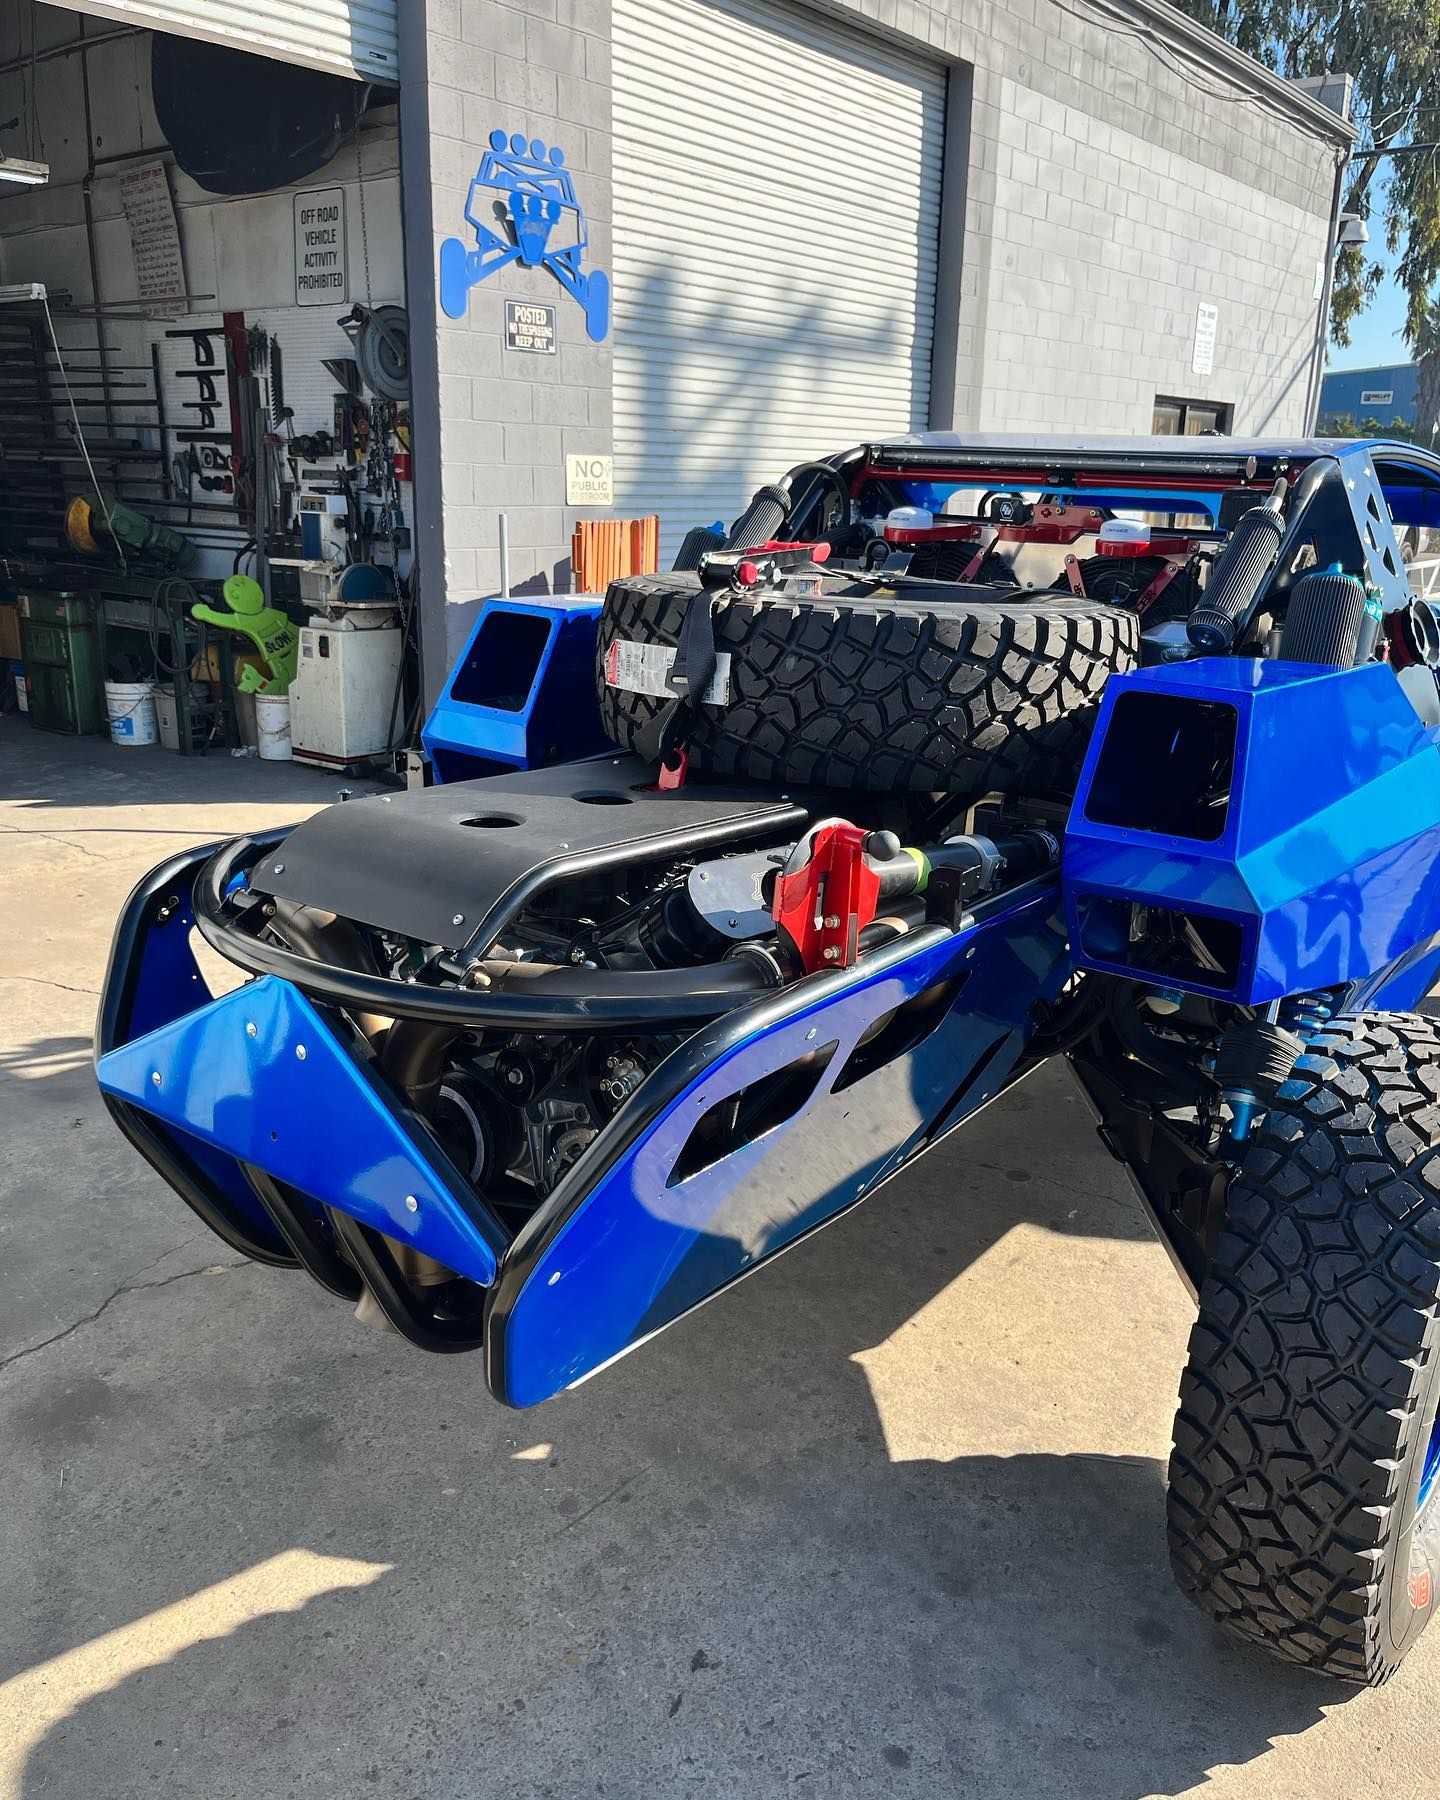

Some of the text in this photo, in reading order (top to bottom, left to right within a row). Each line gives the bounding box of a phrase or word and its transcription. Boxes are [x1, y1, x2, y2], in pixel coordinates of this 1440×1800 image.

[301, 205, 339, 225] OFF ROAD
[305, 228, 337, 247] VEHICLE
[304, 251, 338, 269] ACTIVITY
[298, 272, 343, 290] PROHIBITED
[514, 305, 547, 325] POSTED
[509, 322, 518, 334] NO
[515, 334, 548, 349] KEEP OUT
[575, 460, 604, 478] NO
[571, 481, 608, 491] PUBLIC
[302, 501, 324, 510] JET
